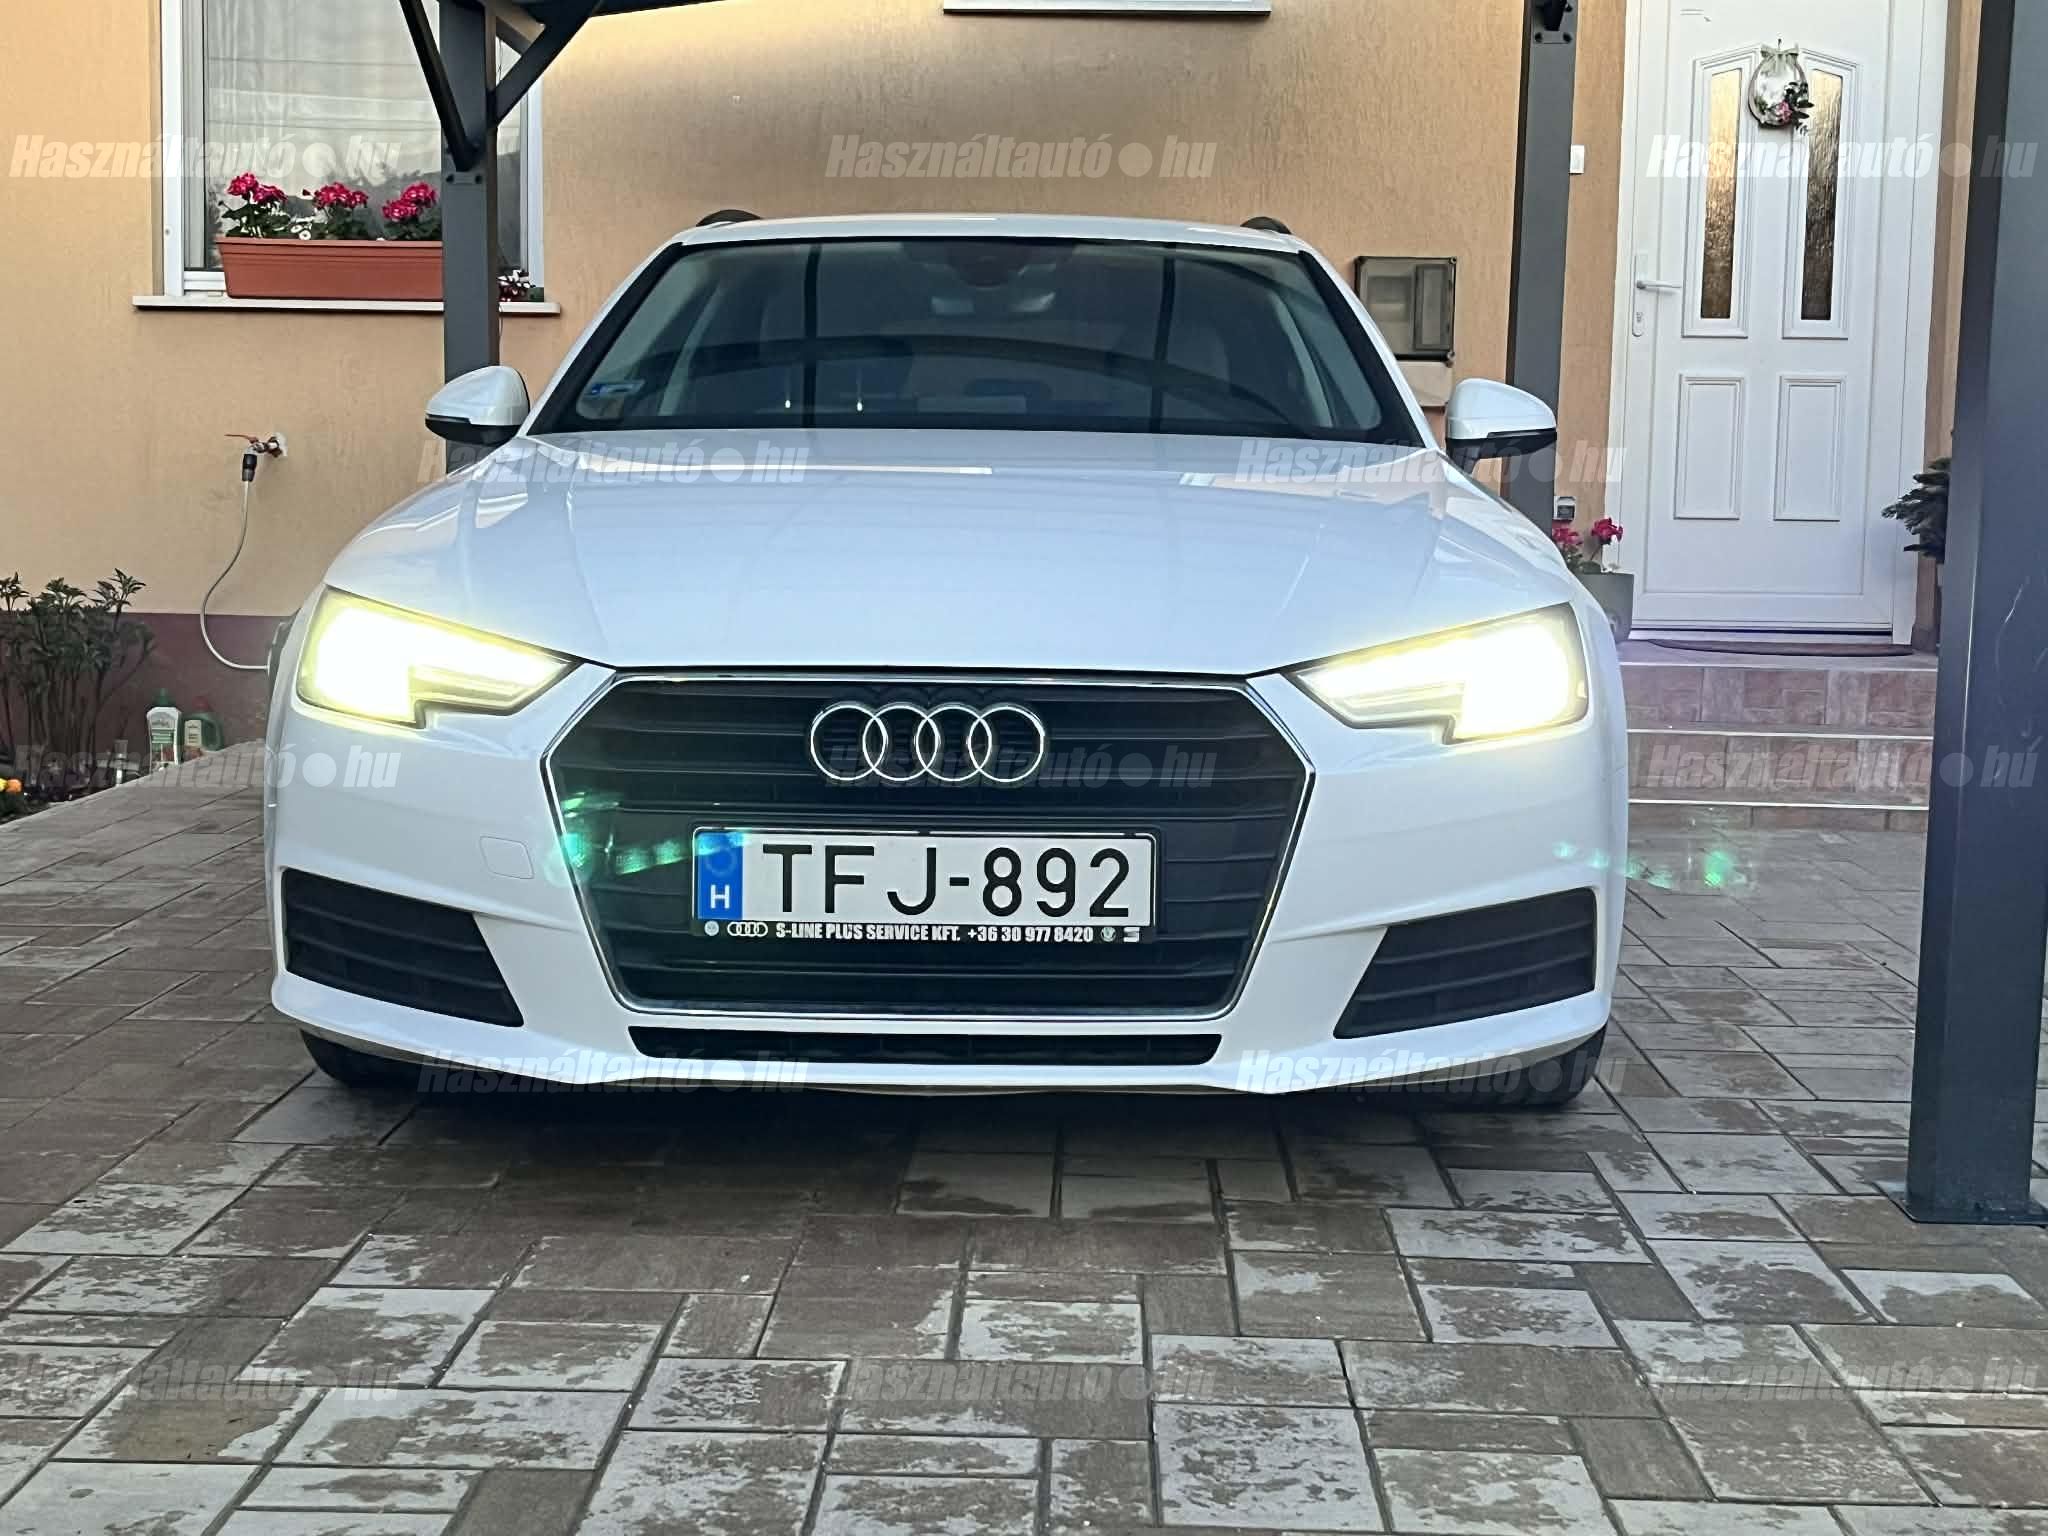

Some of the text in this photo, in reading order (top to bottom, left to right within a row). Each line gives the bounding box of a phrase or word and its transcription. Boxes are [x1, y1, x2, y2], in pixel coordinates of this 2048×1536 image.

[710, 884, 730, 909] H
[776, 923, 1094, 943] S-LINE PLUS SERVICE KFT. +36 30 977 8420
